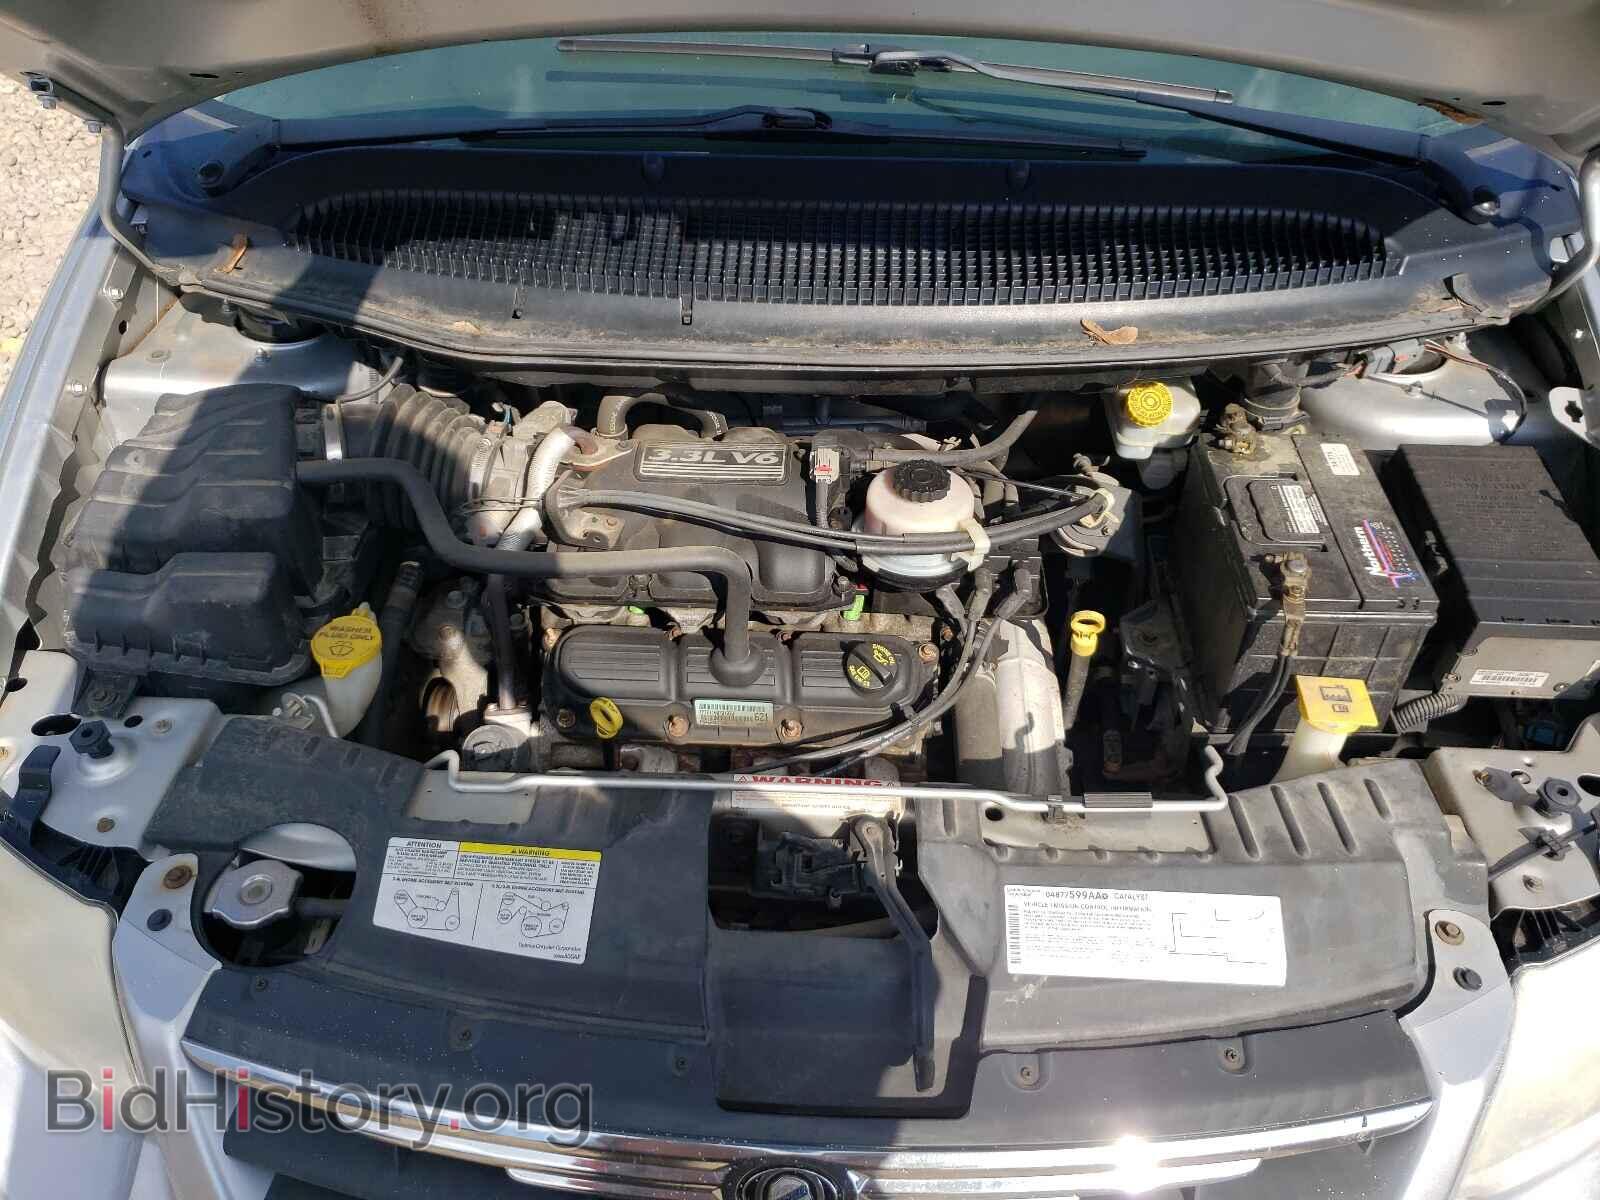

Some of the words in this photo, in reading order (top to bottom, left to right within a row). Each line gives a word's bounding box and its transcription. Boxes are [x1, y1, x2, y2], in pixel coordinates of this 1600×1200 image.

[648, 450, 726, 463] 3.3L
[730, 451, 779, 464] V6
[1353, 526, 1389, 577] Northern
[329, 625, 371, 633] WASHER
[754, 712, 769, 721] 621
[752, 775, 882, 787] WARNING
[406, 841, 442, 849] ATTENTION
[518, 848, 550, 857] WARNING
